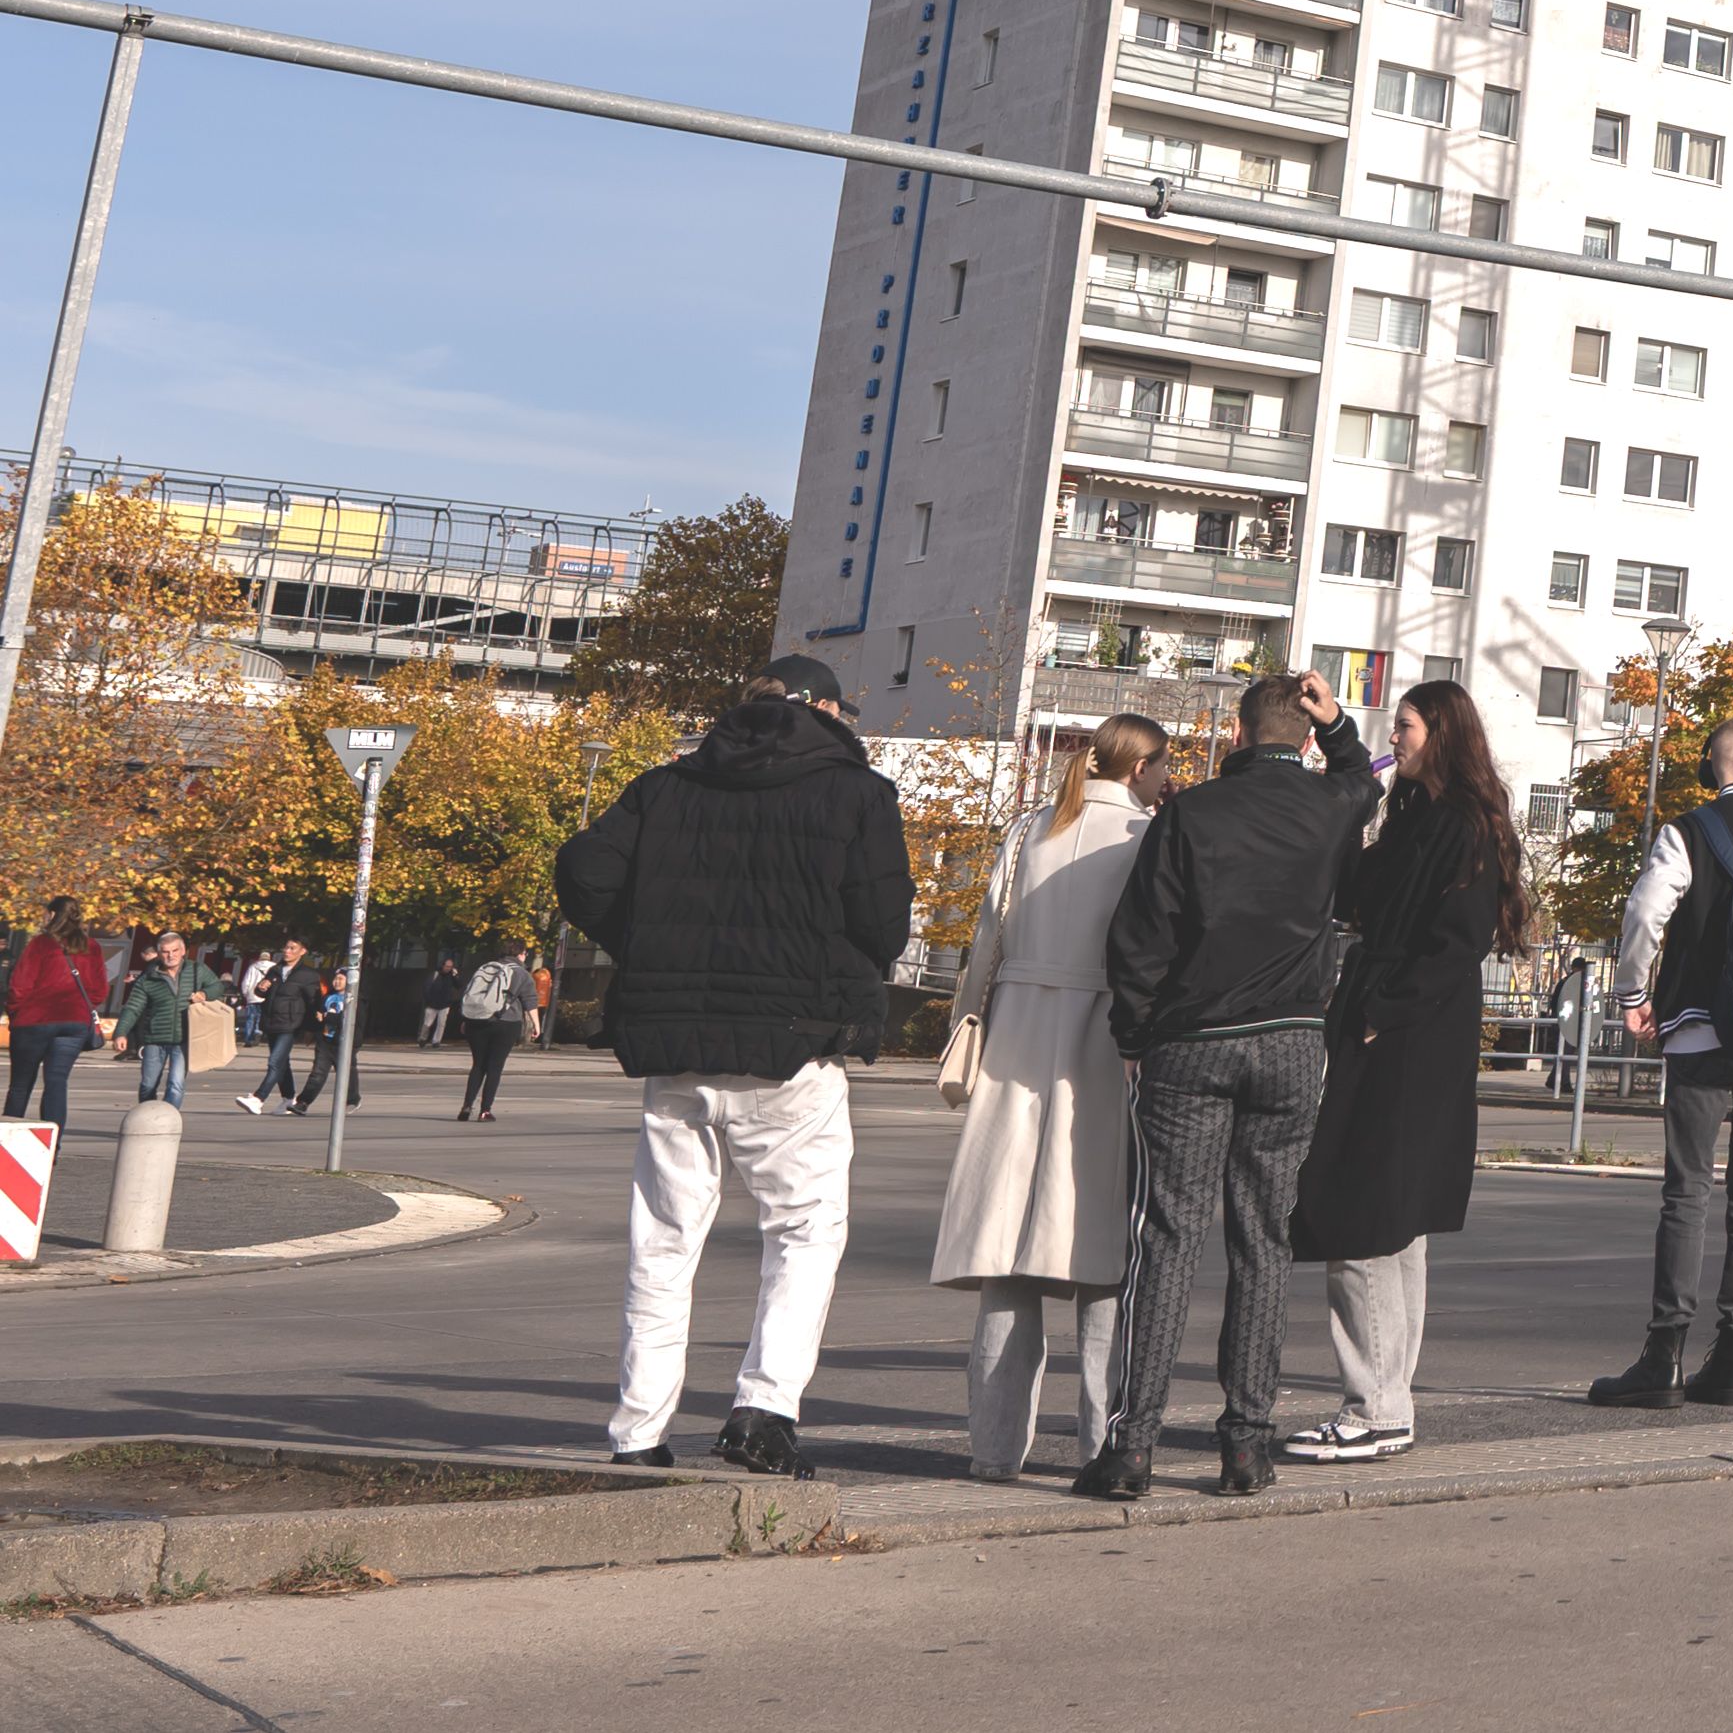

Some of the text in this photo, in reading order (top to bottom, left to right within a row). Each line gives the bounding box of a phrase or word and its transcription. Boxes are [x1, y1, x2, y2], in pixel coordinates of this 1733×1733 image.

[840, 274, 895, 578] PROMENADE
[563, 562, 601, 573] Ausfart
[348, 731, 396, 747] MLM
